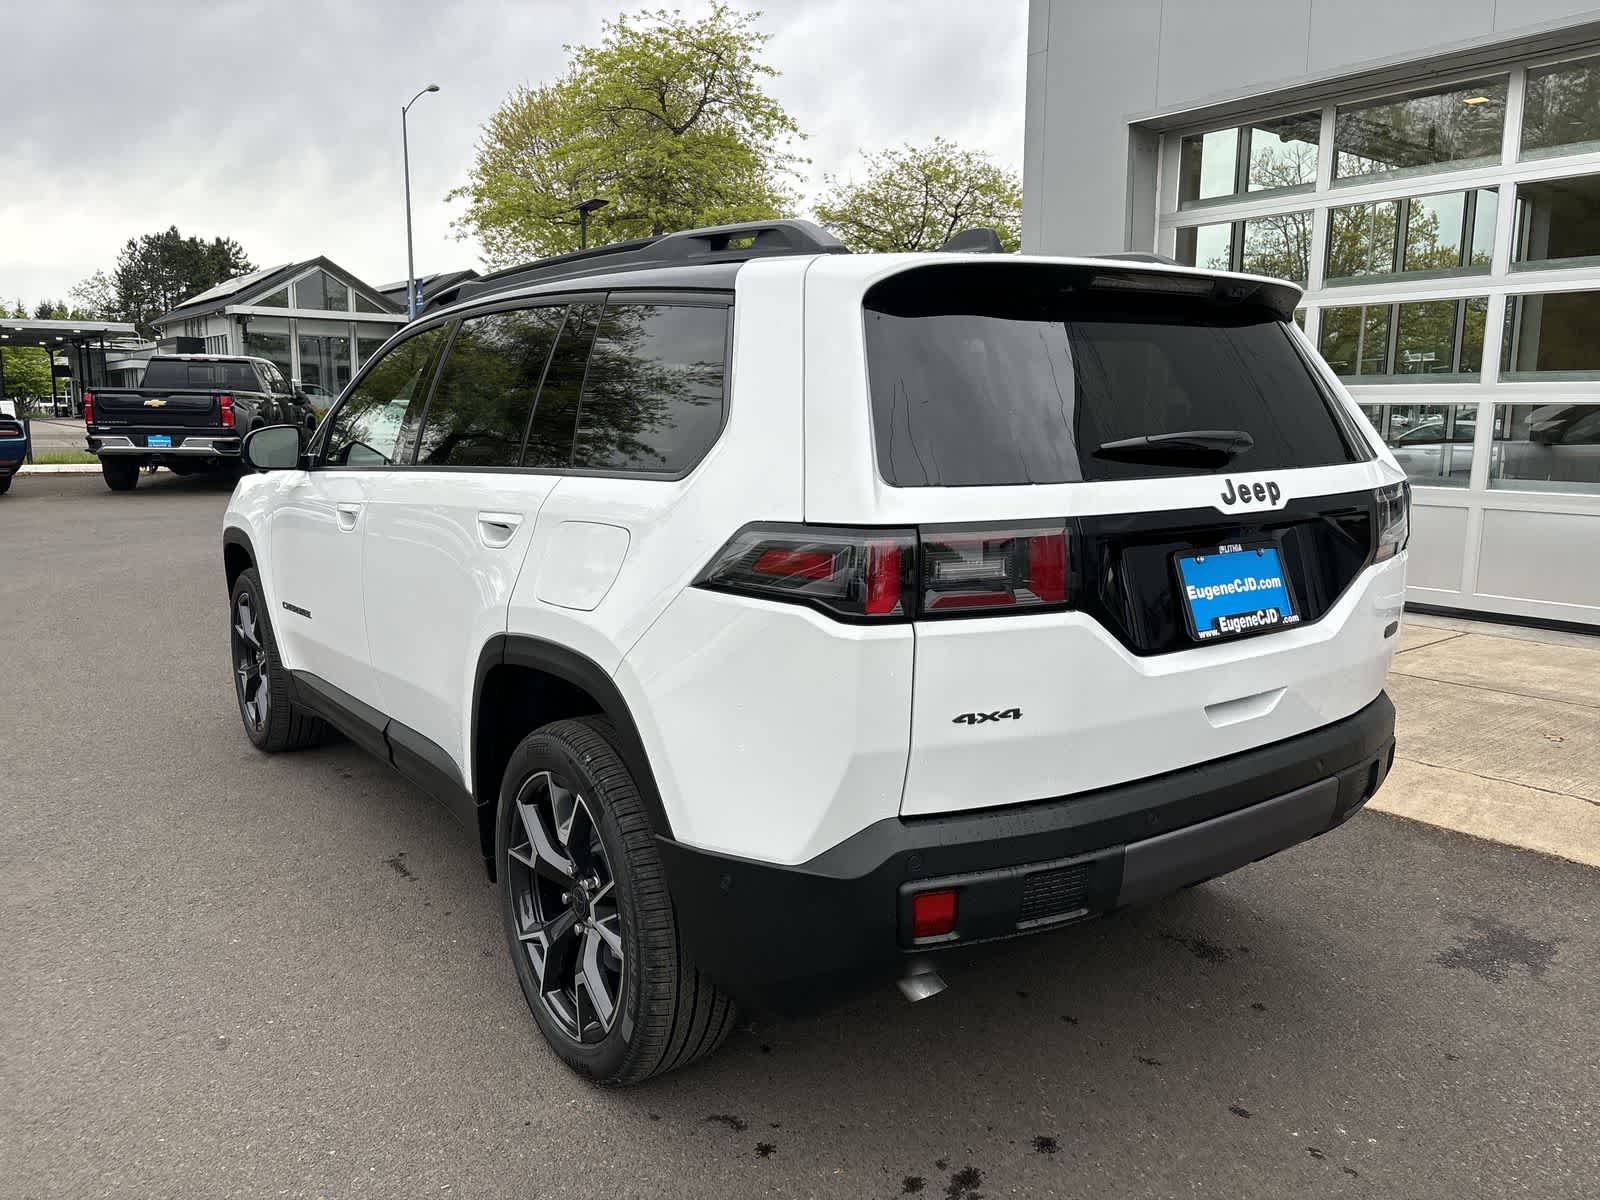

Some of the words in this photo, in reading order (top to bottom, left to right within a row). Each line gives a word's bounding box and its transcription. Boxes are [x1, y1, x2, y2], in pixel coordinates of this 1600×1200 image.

[1220, 478, 1281, 506] Jeep
[1186, 576, 1282, 601] EugeneCJD.com
[1198, 628, 1220, 639] www.
[1219, 608, 1278, 633] EugeneCJD
[1282, 614, 1300, 624] .com
